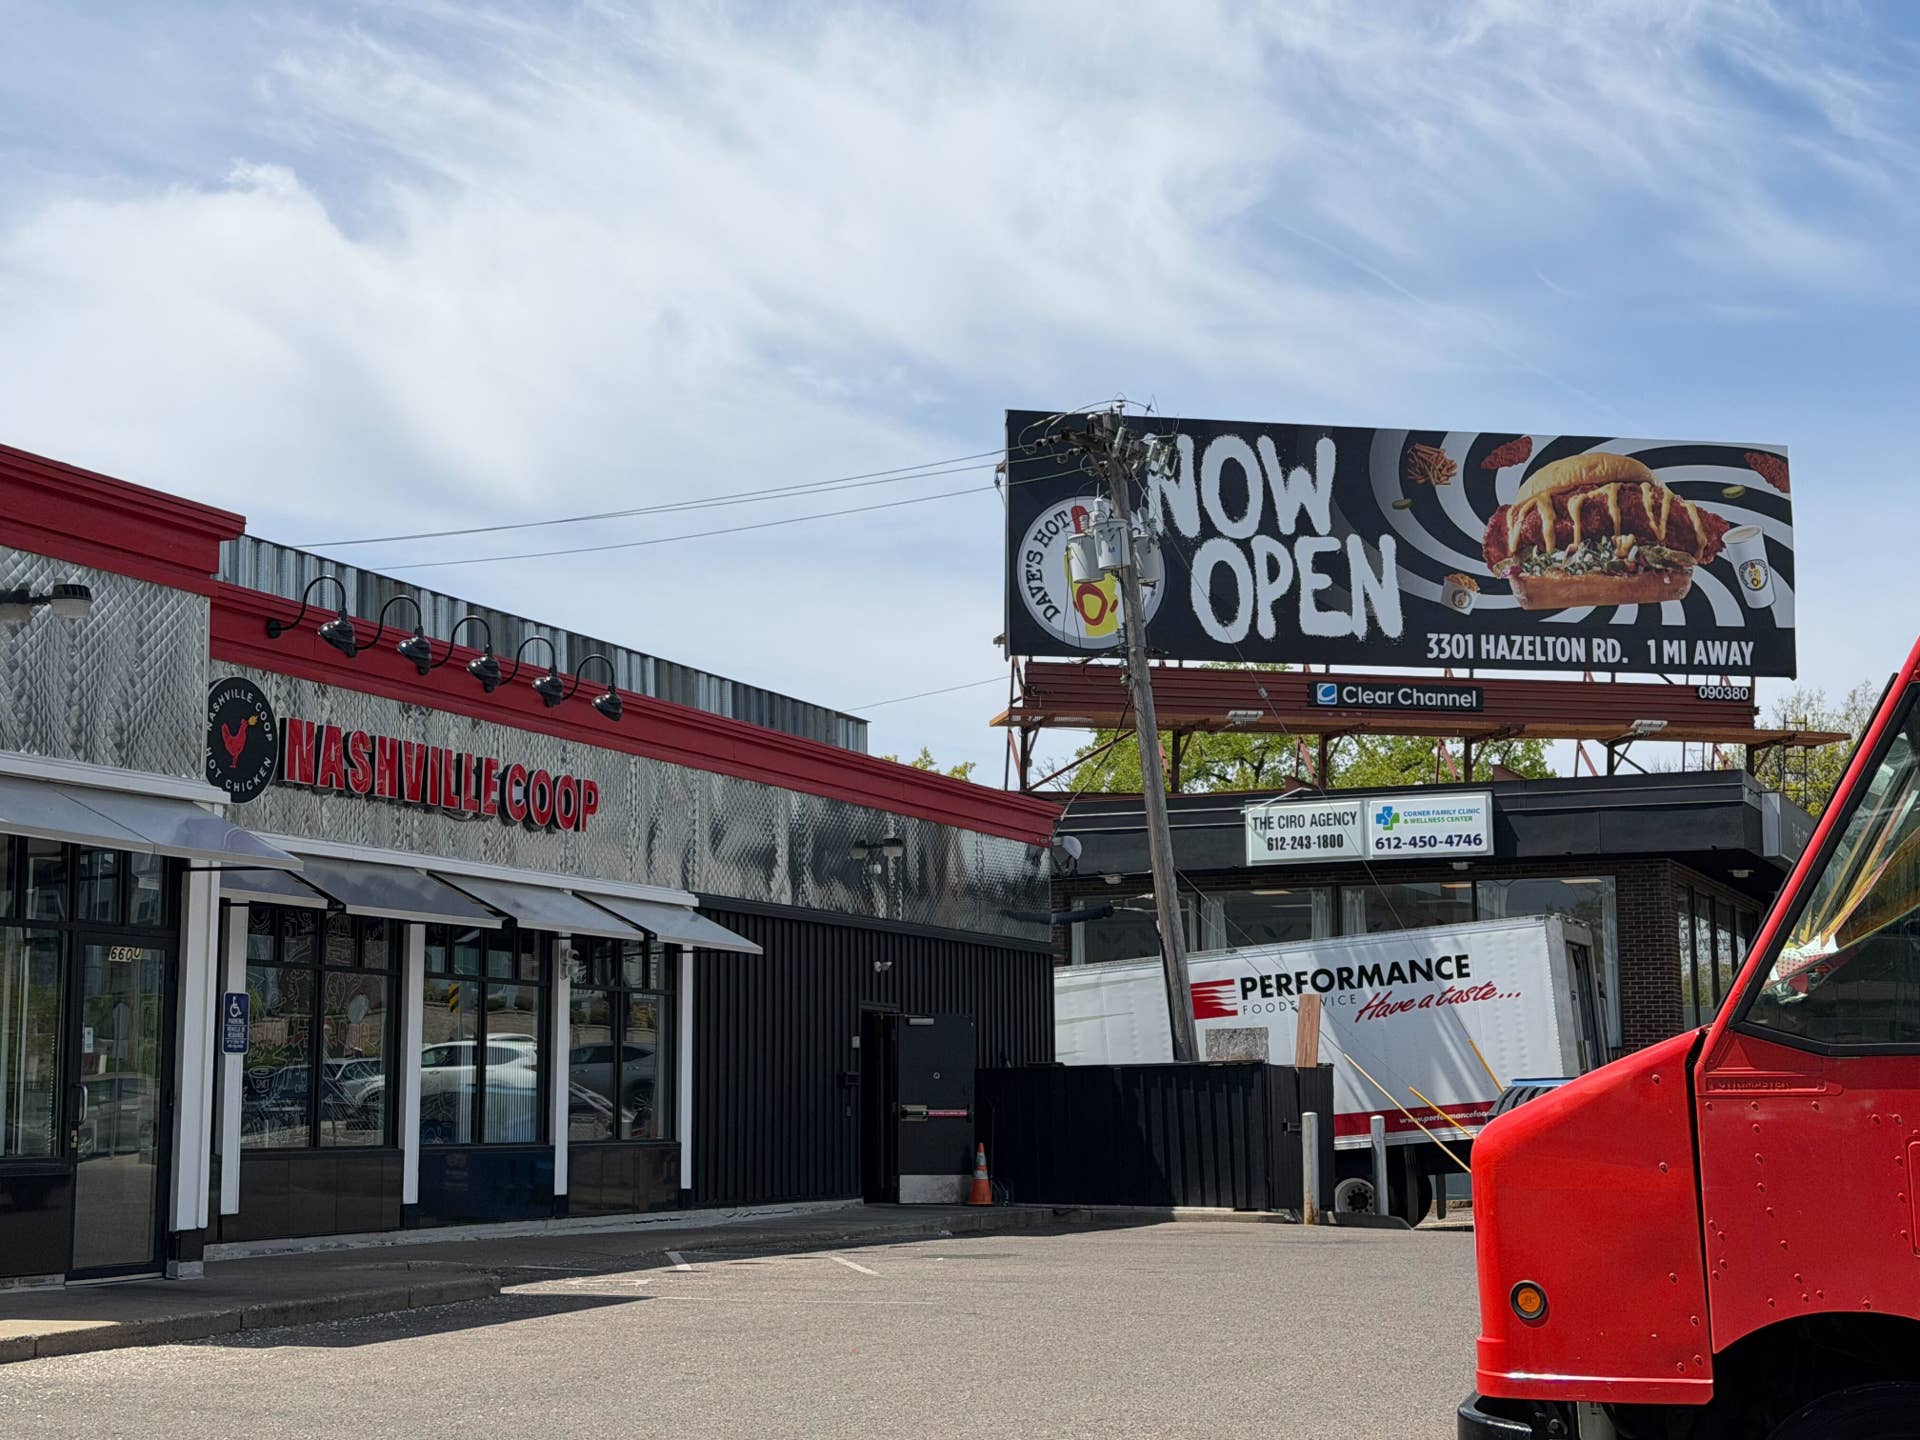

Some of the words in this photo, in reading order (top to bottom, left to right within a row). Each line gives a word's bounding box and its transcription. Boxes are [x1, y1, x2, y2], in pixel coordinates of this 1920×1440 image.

[1144, 433, 1336, 539] NOW
[1033, 510, 1072, 548] HOT
[1025, 550, 1062, 623] DAVE'S
[1191, 533, 1404, 644] OPEN
[1426, 633, 1473, 660] 3301
[1480, 634, 1586, 663] HAZELTON
[1592, 637, 1629, 664] RD.
[1648, 639, 1657, 665] 1
[1663, 639, 1688, 665] MI
[1693, 641, 1755, 666] AWAY
[1342, 686, 1395, 705] Clear
[1398, 687, 1477, 708] Channel
[1699, 685, 1749, 700] 090380
[255, 702, 273, 742] COOP
[205, 746, 222, 779] HOT
[225, 756, 272, 793] CHICKEN
[279, 717, 499, 816] NASHVILLE
[500, 763, 599, 833] COOP
[1252, 815, 1275, 831] THE
[1277, 814, 1306, 830] CIRO
[1310, 811, 1357, 828] AGENCY
[1410, 816, 1446, 824] WELLNESS
[1446, 815, 1473, 823] CENTER
[1431, 808, 1457, 816] FAMILY
[1457, 807, 1481, 815] CLINIC
[1267, 834, 1344, 851] 612-243-1800
[1374, 833, 1483, 850] 612-450-4746
[110, 947, 140, 961] 6600
[1240, 953, 1471, 1001] PERFORMANCE
[1243, 993, 1357, 1016] FOODSVICE
[1354, 990, 1417, 1024] Have
[1418, 993, 1435, 1008] a
